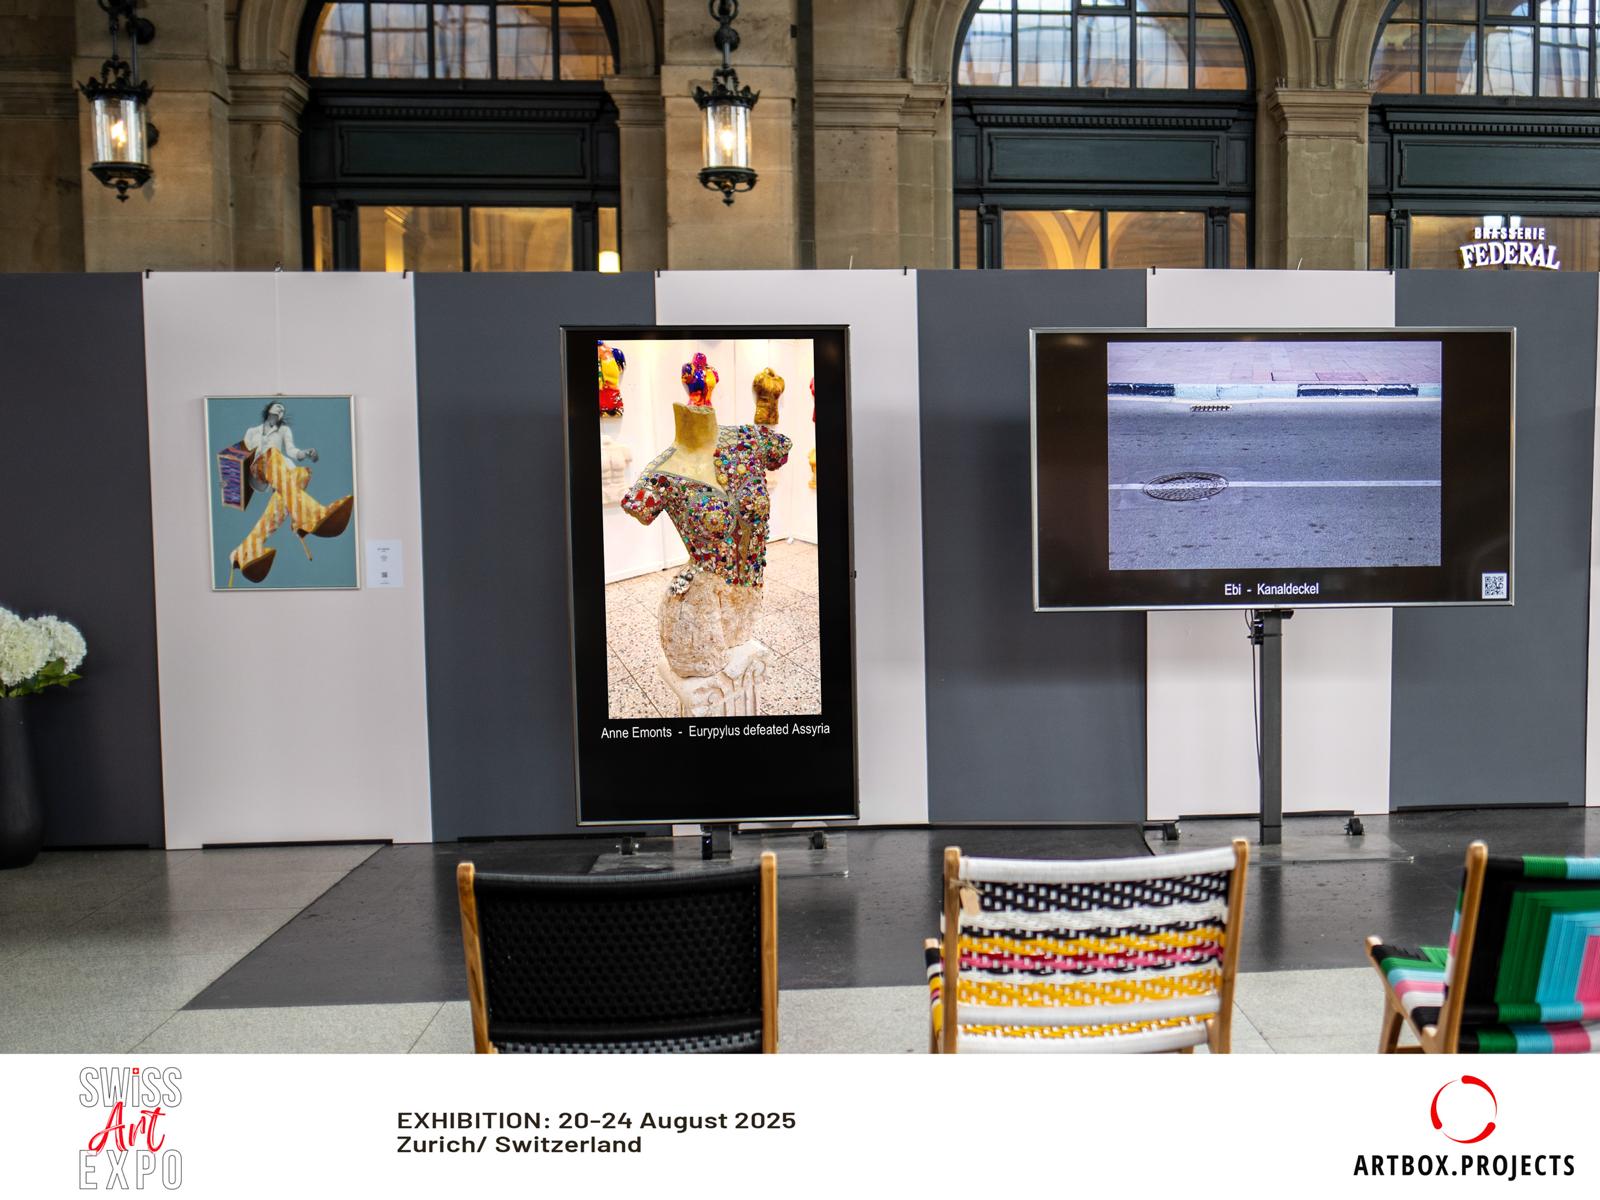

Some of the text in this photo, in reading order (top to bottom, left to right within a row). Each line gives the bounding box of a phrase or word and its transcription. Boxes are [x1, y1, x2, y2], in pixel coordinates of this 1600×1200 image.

[1474, 227, 1545, 240] BRASSERIE
[1460, 241, 1560, 270] FEDERAL
[1224, 583, 1242, 596] Ebi
[1257, 582, 1319, 596] Kanaldeckel
[600, 727, 629, 739] Anne
[632, 726, 673, 739] Emonts
[689, 724, 741, 740] Eurypylus
[743, 723, 789, 736] defeated
[791, 722, 831, 737] Assyria
